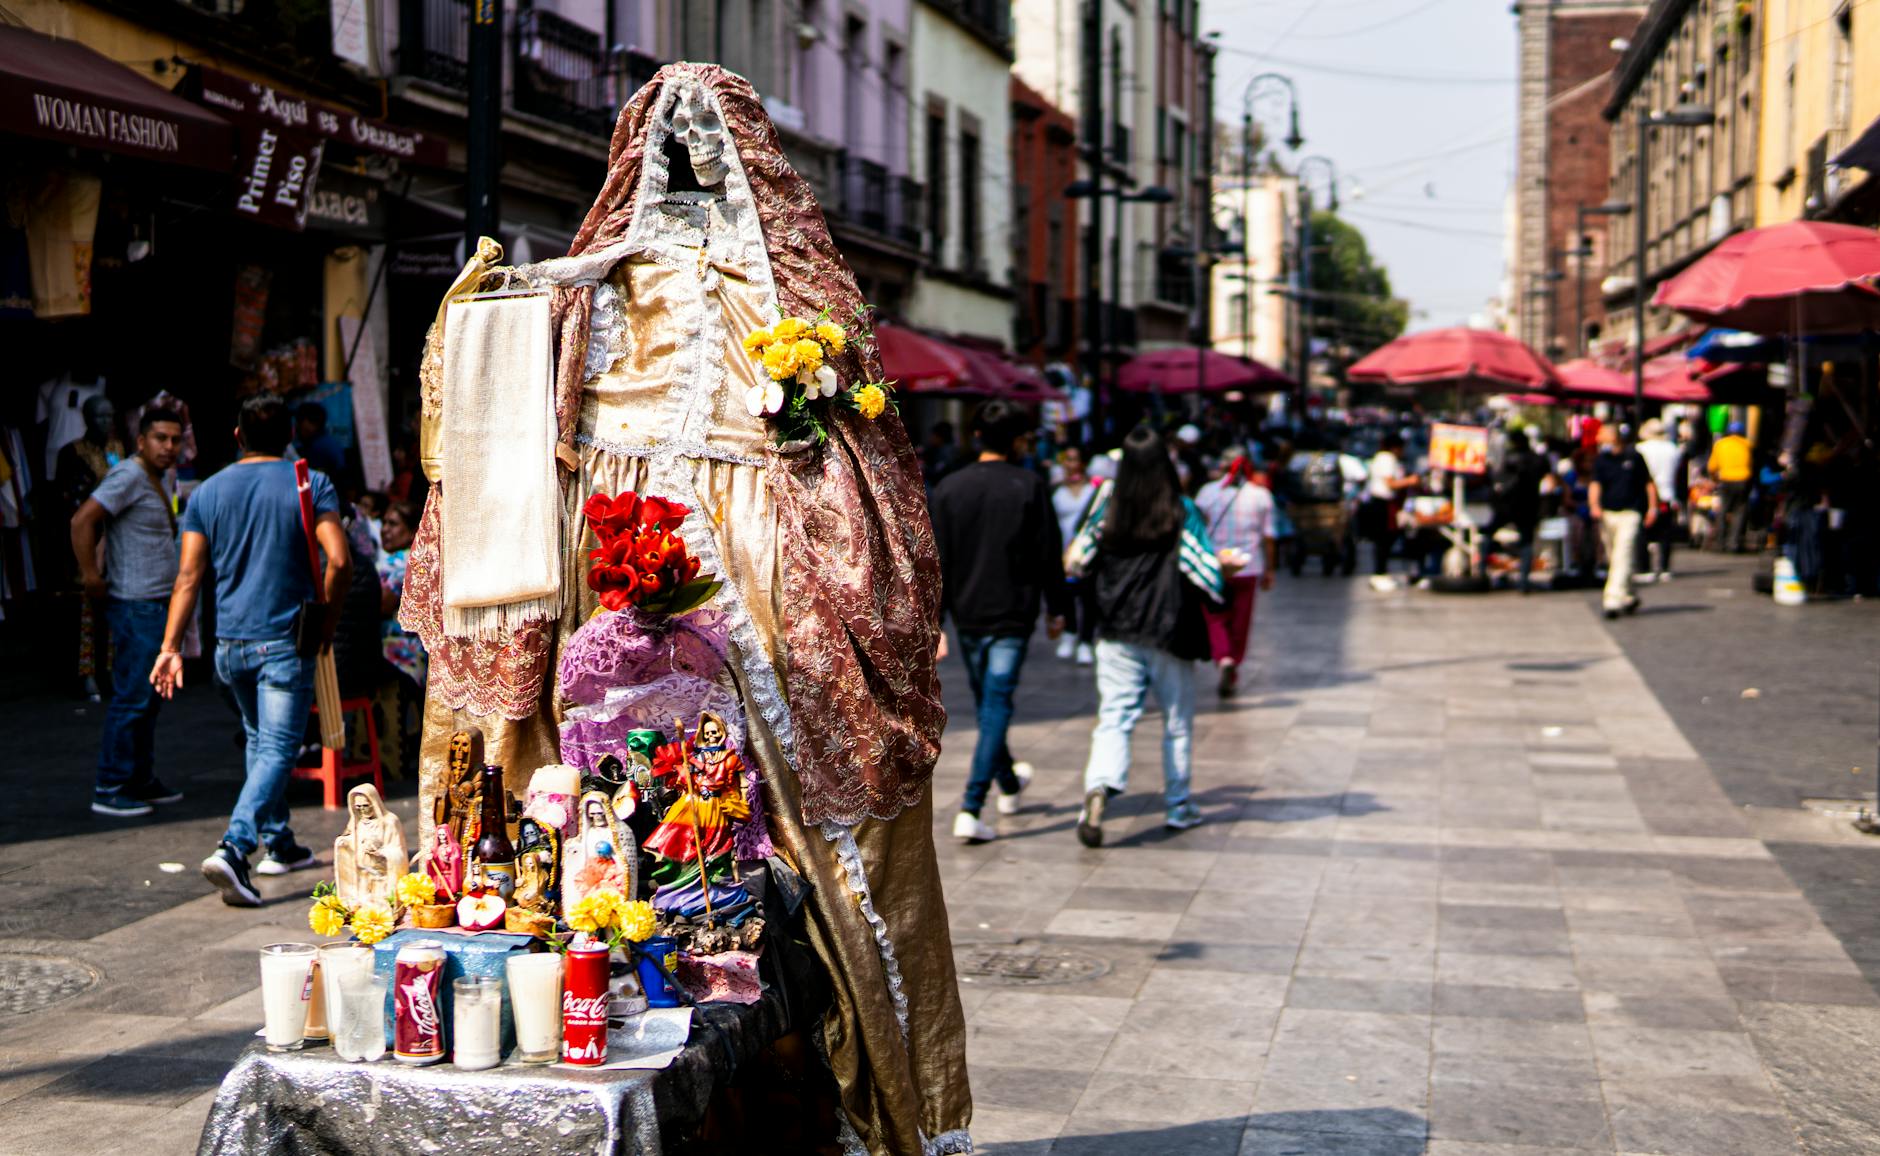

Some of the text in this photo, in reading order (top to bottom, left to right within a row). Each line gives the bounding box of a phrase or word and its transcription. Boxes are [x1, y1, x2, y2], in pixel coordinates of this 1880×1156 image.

[34, 93, 178, 151] WOMAN FASHION
[319, 111, 339, 133] es
[237, 128, 278, 214] Primer
[275, 155, 306, 207] Piso
